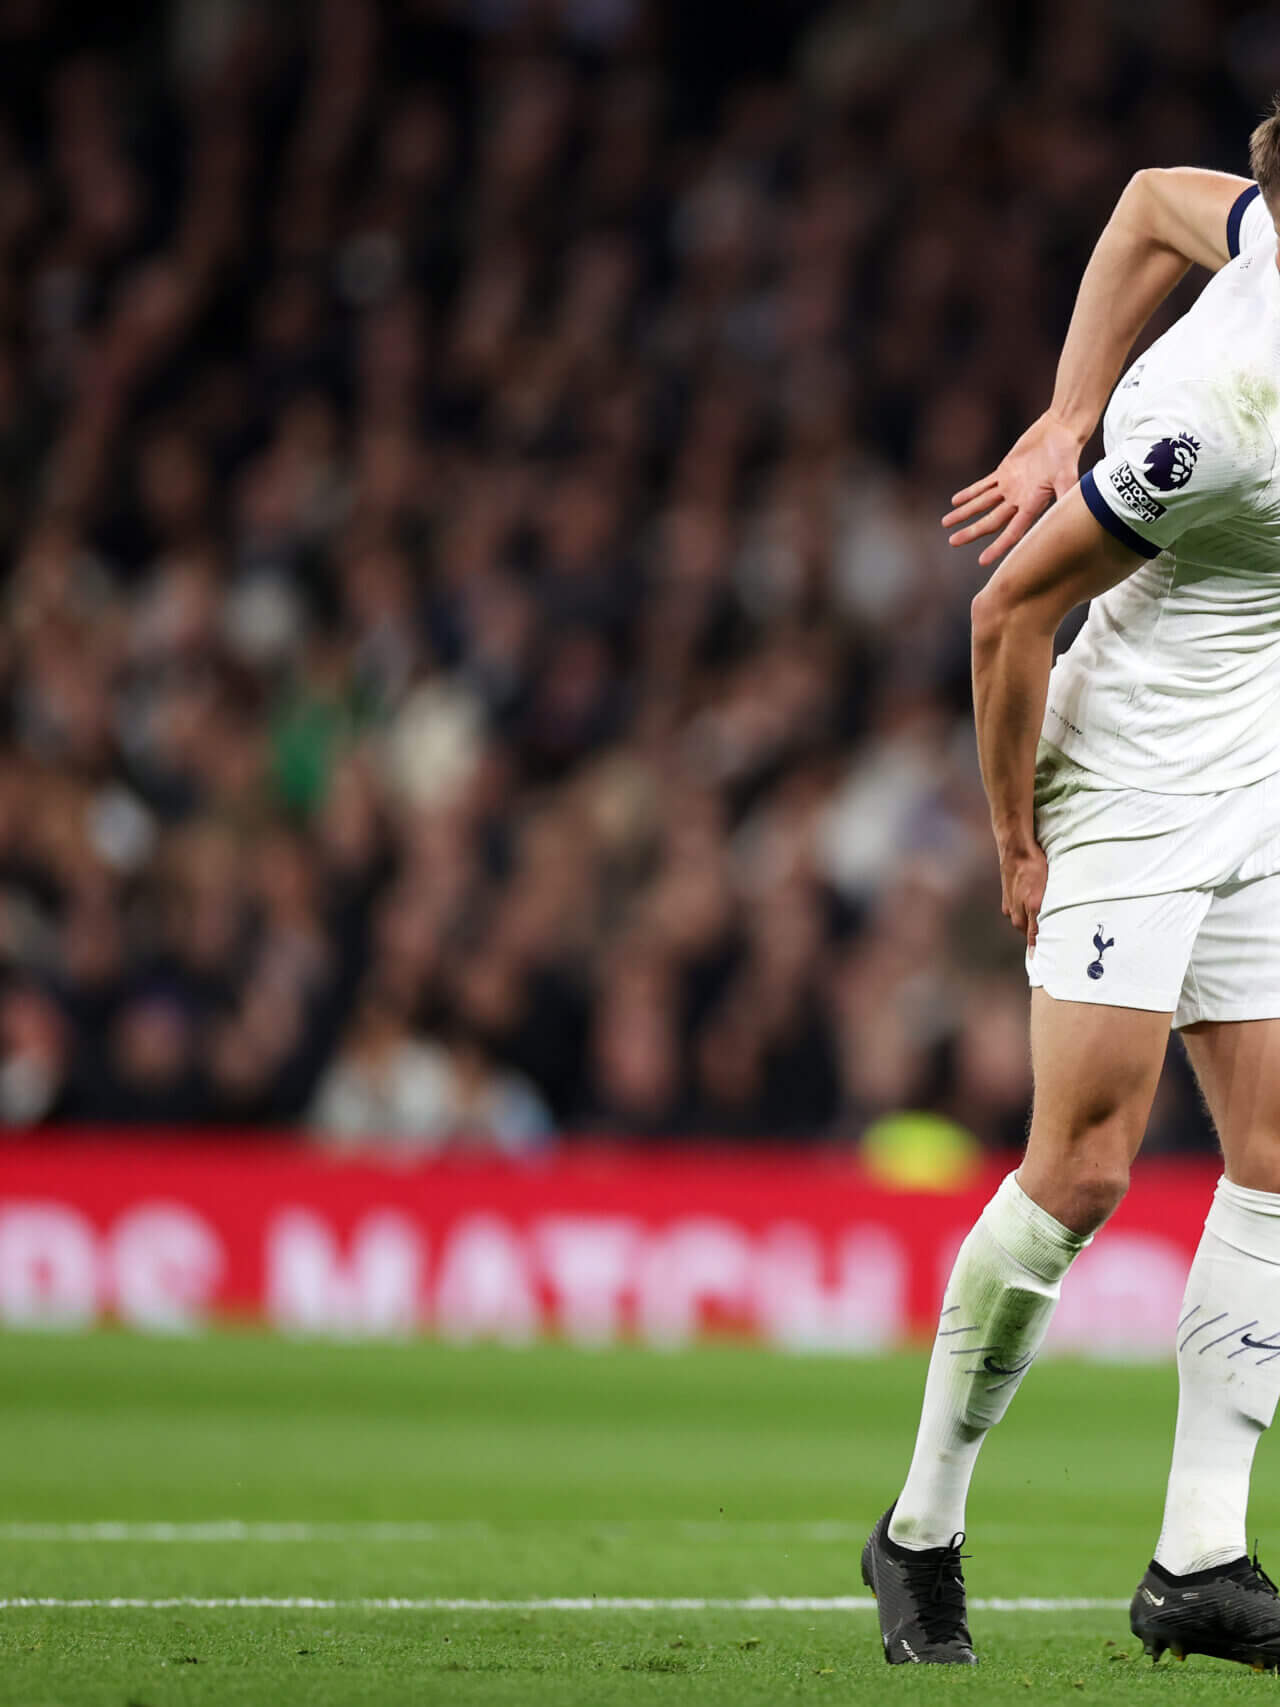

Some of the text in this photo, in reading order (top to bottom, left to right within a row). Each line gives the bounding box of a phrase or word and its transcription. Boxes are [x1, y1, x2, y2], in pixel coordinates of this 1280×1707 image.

[1119, 461, 1160, 513] No room
[1120, 487, 1156, 523] racism
[266, 1206, 906, 1352] MATCH
